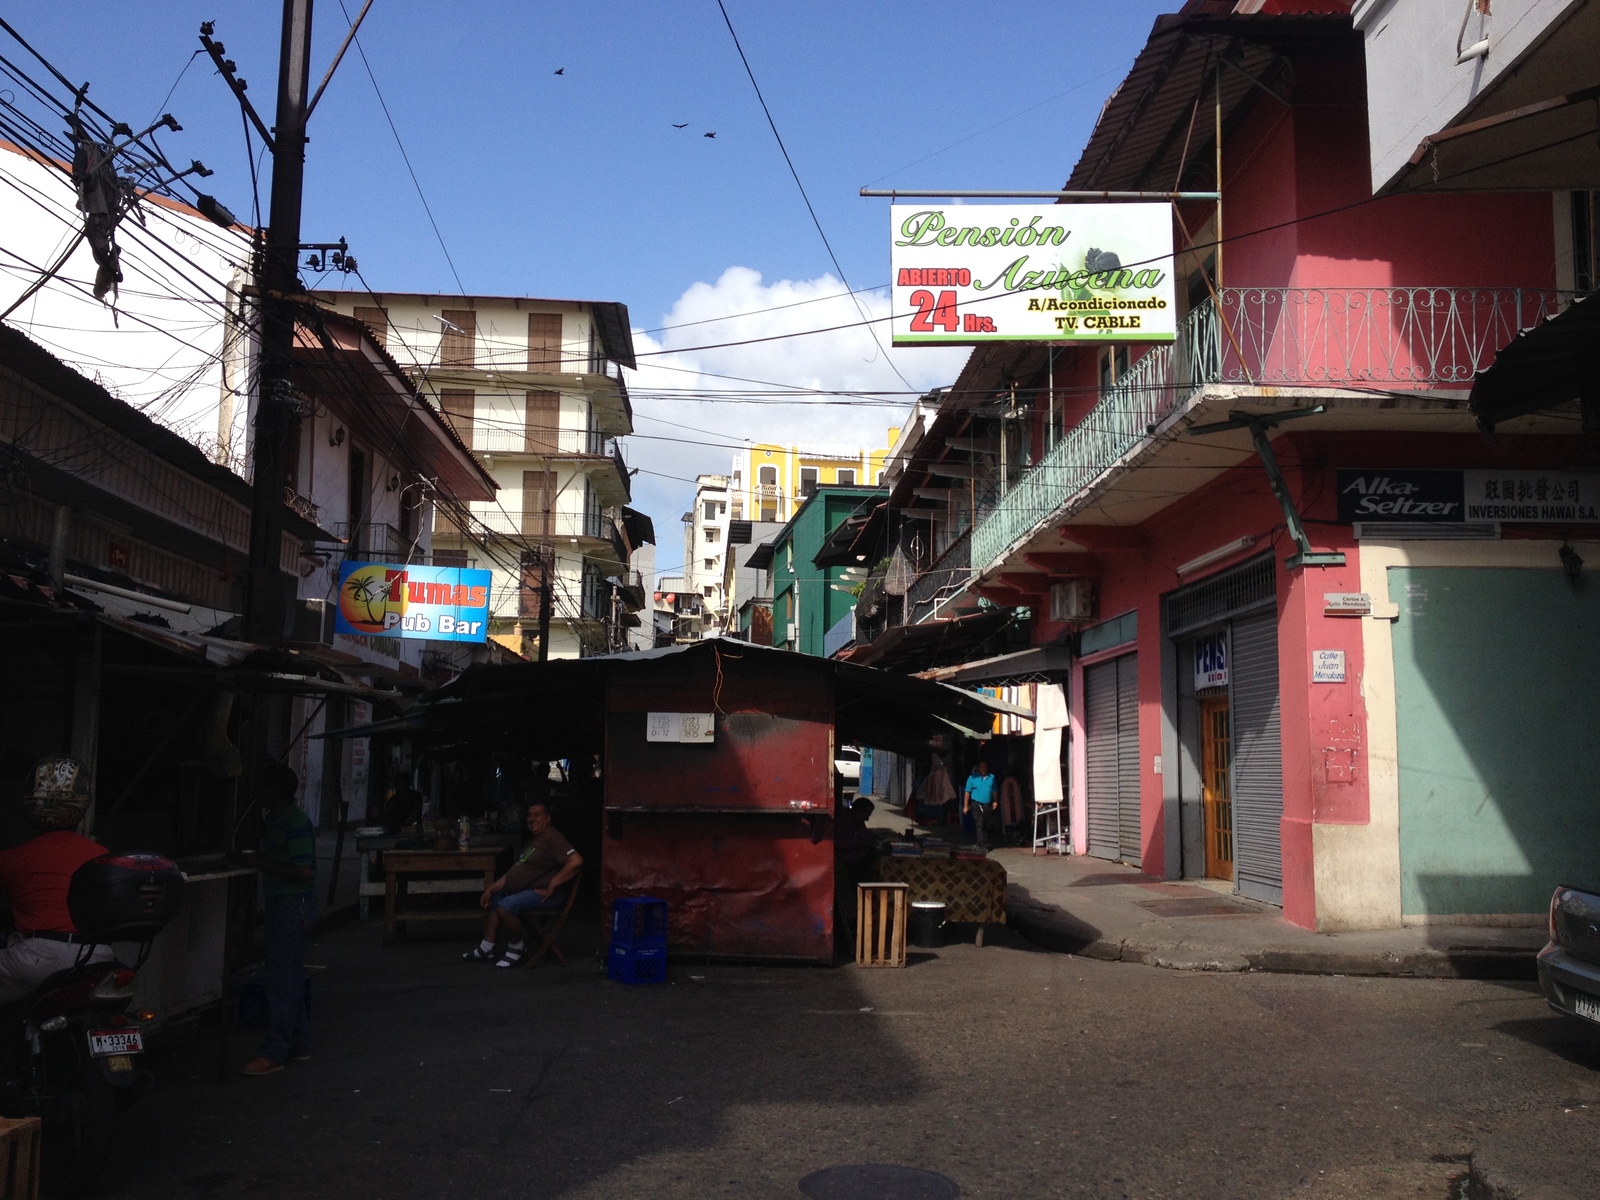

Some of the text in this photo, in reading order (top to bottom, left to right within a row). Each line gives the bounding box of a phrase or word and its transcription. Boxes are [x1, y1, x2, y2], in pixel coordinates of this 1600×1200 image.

[895, 210, 1071, 247] Pensión
[897, 267, 971, 287] ABIERTO
[973, 254, 1166, 291] Azucena
[909, 289, 960, 332] 24
[1027, 297, 1167, 312] A/Acondicionado
[963, 313, 998, 333] Hrs.
[1055, 316, 1141, 330] TV. CABLE
[1342, 476, 1420, 495] Alka-
[1355, 496, 1460, 515] Seltzer
[1468, 504, 1599, 520] INVERSIONES HAWAI S.A.
[385, 569, 487, 608] Tumas
[383, 611, 482, 636] Pub Bar
[1319, 651, 1339, 660] Calle
[1314, 670, 1345, 680] Mendoza
[1318, 661, 1339, 670] Juan
